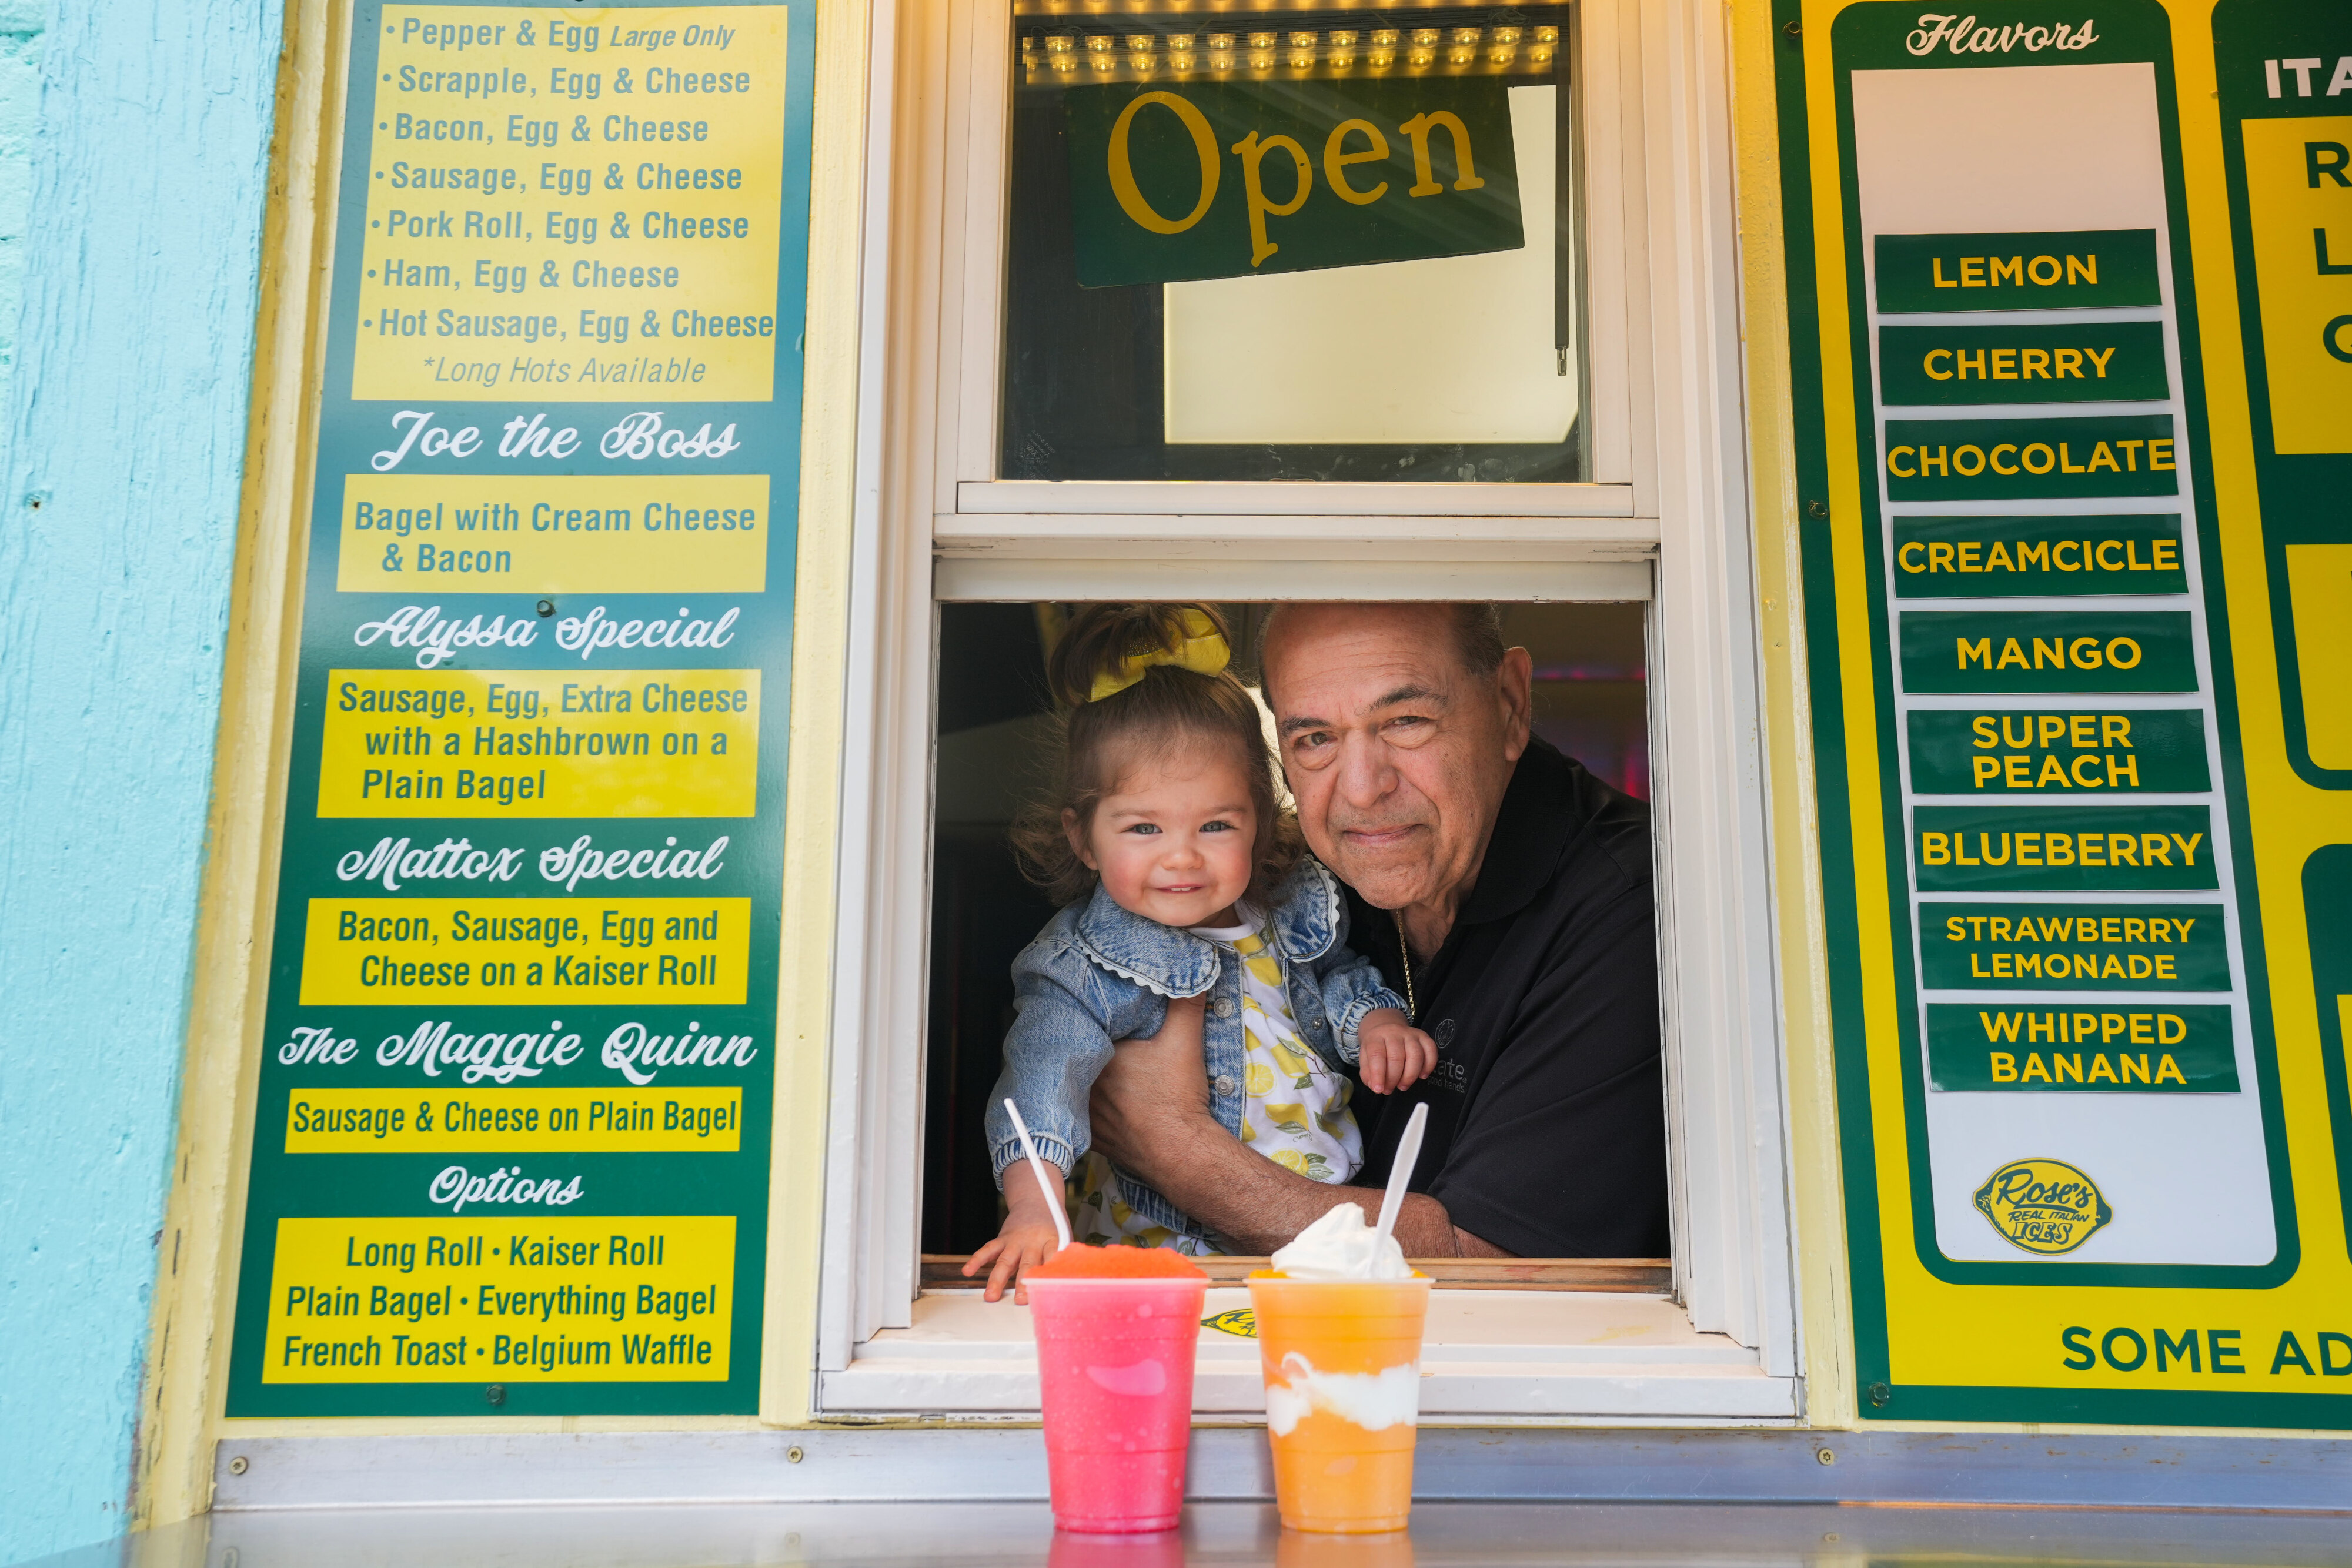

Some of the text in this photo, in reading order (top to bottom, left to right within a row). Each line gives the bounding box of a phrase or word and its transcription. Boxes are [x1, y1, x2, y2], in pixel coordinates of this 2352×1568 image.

[403, 18, 736, 52] Pepper & Egg Large Only
[1906, 14, 2099, 55] Flavors
[399, 65, 749, 99] Scrapple, Egg & Cheese
[395, 113, 708, 147] Bacon, Egg & Cheese
[392, 162, 741, 195] Sausage, Egg & Cheese
[1107, 90, 1485, 268] Open
[388, 210, 748, 244] Pork Roll, Egg & Cheese
[384, 259, 678, 293] Ham, Egg & Cheese
[1933, 255, 2097, 287] LEMON
[380, 309, 773, 343] Hot Sausage, Egg & Cheese
[509, 357, 571, 382] Hots
[578, 357, 706, 382] Available
[1924, 348, 2115, 380] CHERRY
[372, 410, 740, 471] Joe the Boss
[1887, 439, 2176, 477] CHOCOLATE
[355, 502, 754, 537] Bagel with Cream Cheese
[382, 543, 510, 573] & Bacon
[1899, 540, 2179, 573] CREAMCICLE
[355, 606, 740, 668] Alyssa Special
[1957, 637, 2141, 669] MANGO
[339, 682, 747, 719] Sausage, Egg, Extra Cheese
[366, 726, 727, 755] with a Hashbrown on a
[1973, 716, 2133, 748] SUPER
[363, 770, 545, 805] Plain Bagel
[1973, 755, 2139, 787] PEACH
[337, 835, 729, 892] Mattox Special
[1923, 833, 2203, 865] BLUEBERRY
[339, 910, 717, 947] Bacon, Sausage, Egg and
[1947, 917, 2195, 942] STRAWBERRY
[361, 955, 716, 986] Cheese on a Kaiser Roll
[1971, 954, 2177, 979] LEMONADE
[1980, 1012, 2186, 1044] WHIPPED
[279, 1021, 757, 1085] The Maggie Quinn
[1990, 1052, 2187, 1084] BANANA
[294, 1101, 736, 1138] Sausage & Cheese on Plain Bagel
[429, 1166, 584, 1213] Options
[1996, 1168, 2093, 1208] Rose's
[2007, 1209, 2090, 1222] REAL ITALIAN
[2011, 1222, 2073, 1245] ICES
[347, 1236, 663, 1273] Long Roll Kaiser Roll
[287, 1285, 715, 1322] Plain Bagel Everything Bagel
[284, 1335, 711, 1372] French Toast Belgium Waffle
[2062, 1326, 2246, 1373] SOME
